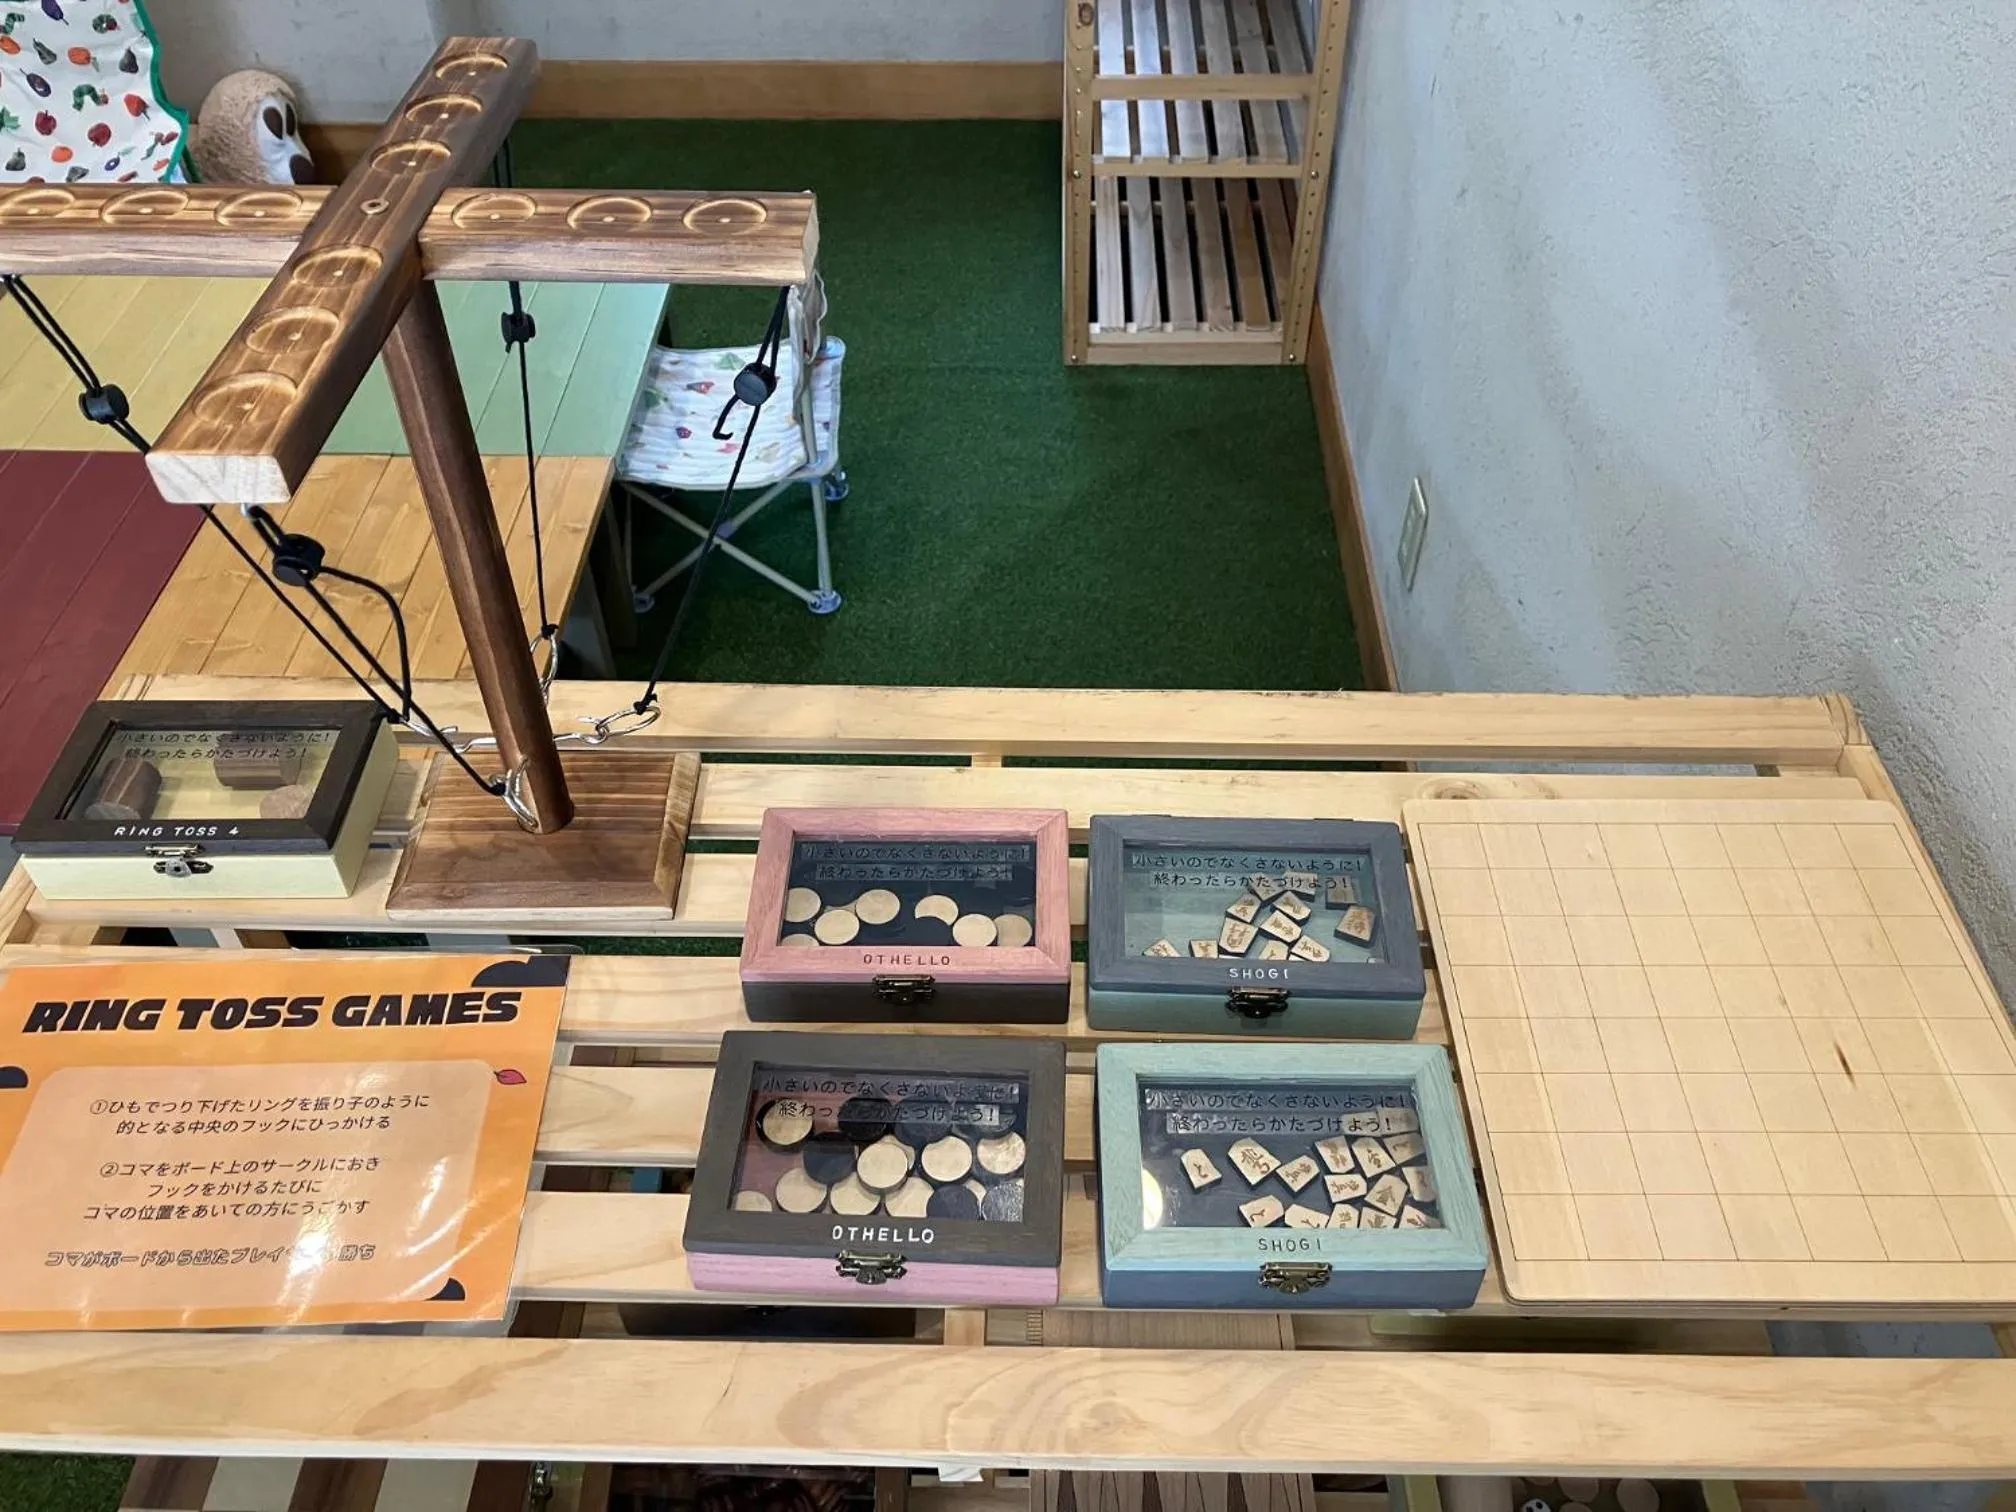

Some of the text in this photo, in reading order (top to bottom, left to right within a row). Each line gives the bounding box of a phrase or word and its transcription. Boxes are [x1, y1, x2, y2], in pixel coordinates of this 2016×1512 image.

[114, 826, 163, 837] RING
[174, 826, 218, 837] TOSS
[863, 953, 951, 966] OTHELLO
[1228, 967, 1289, 980] SHOGI
[22, 991, 522, 1034] RING TOSS GAMES
[116, 1117, 391, 1136] 的となる中央のフックにひっかける
[100, 1157, 382, 1178] ②コマをボード上のサークルにおき
[147, 1179, 323, 1199] フックをかけるたびに
[83, 1199, 371, 1222] コマの位置をあいての方にうごかす
[832, 1225, 935, 1243] OTHELLO
[1257, 1237, 1322, 1253] SHOGI
[44, 1244, 377, 1267] コマがボードから出たプレイ勝ち
